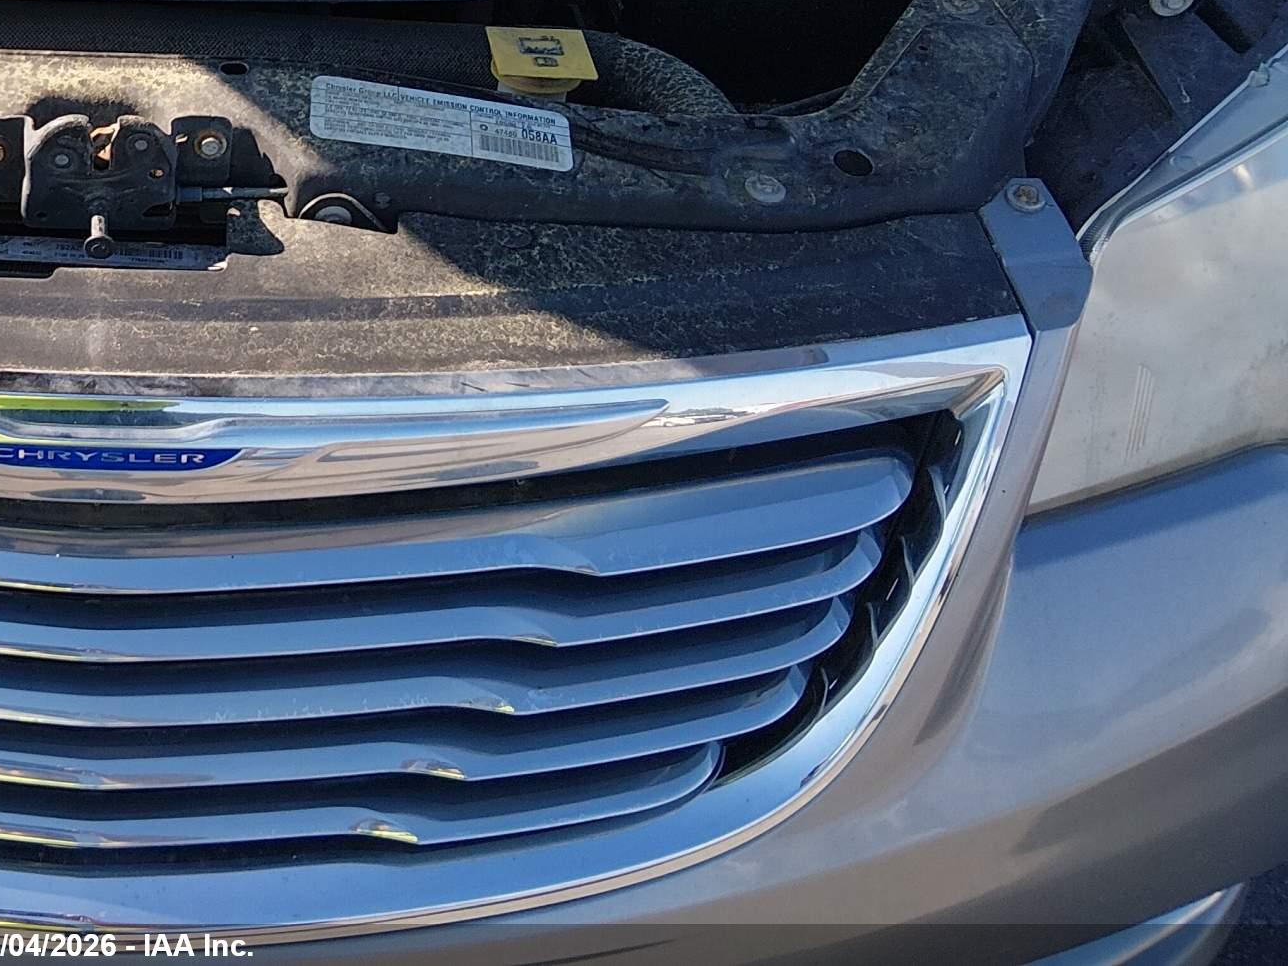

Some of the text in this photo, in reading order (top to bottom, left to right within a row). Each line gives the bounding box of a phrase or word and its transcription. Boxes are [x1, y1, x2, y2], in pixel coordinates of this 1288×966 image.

[400, 93, 431, 106] VEHICLE
[433, 98, 468, 111] EMISSION
[469, 103, 503, 117] CONTROL
[505, 109, 556, 125] INFORMATION
[521, 128, 558, 145] 058AA
